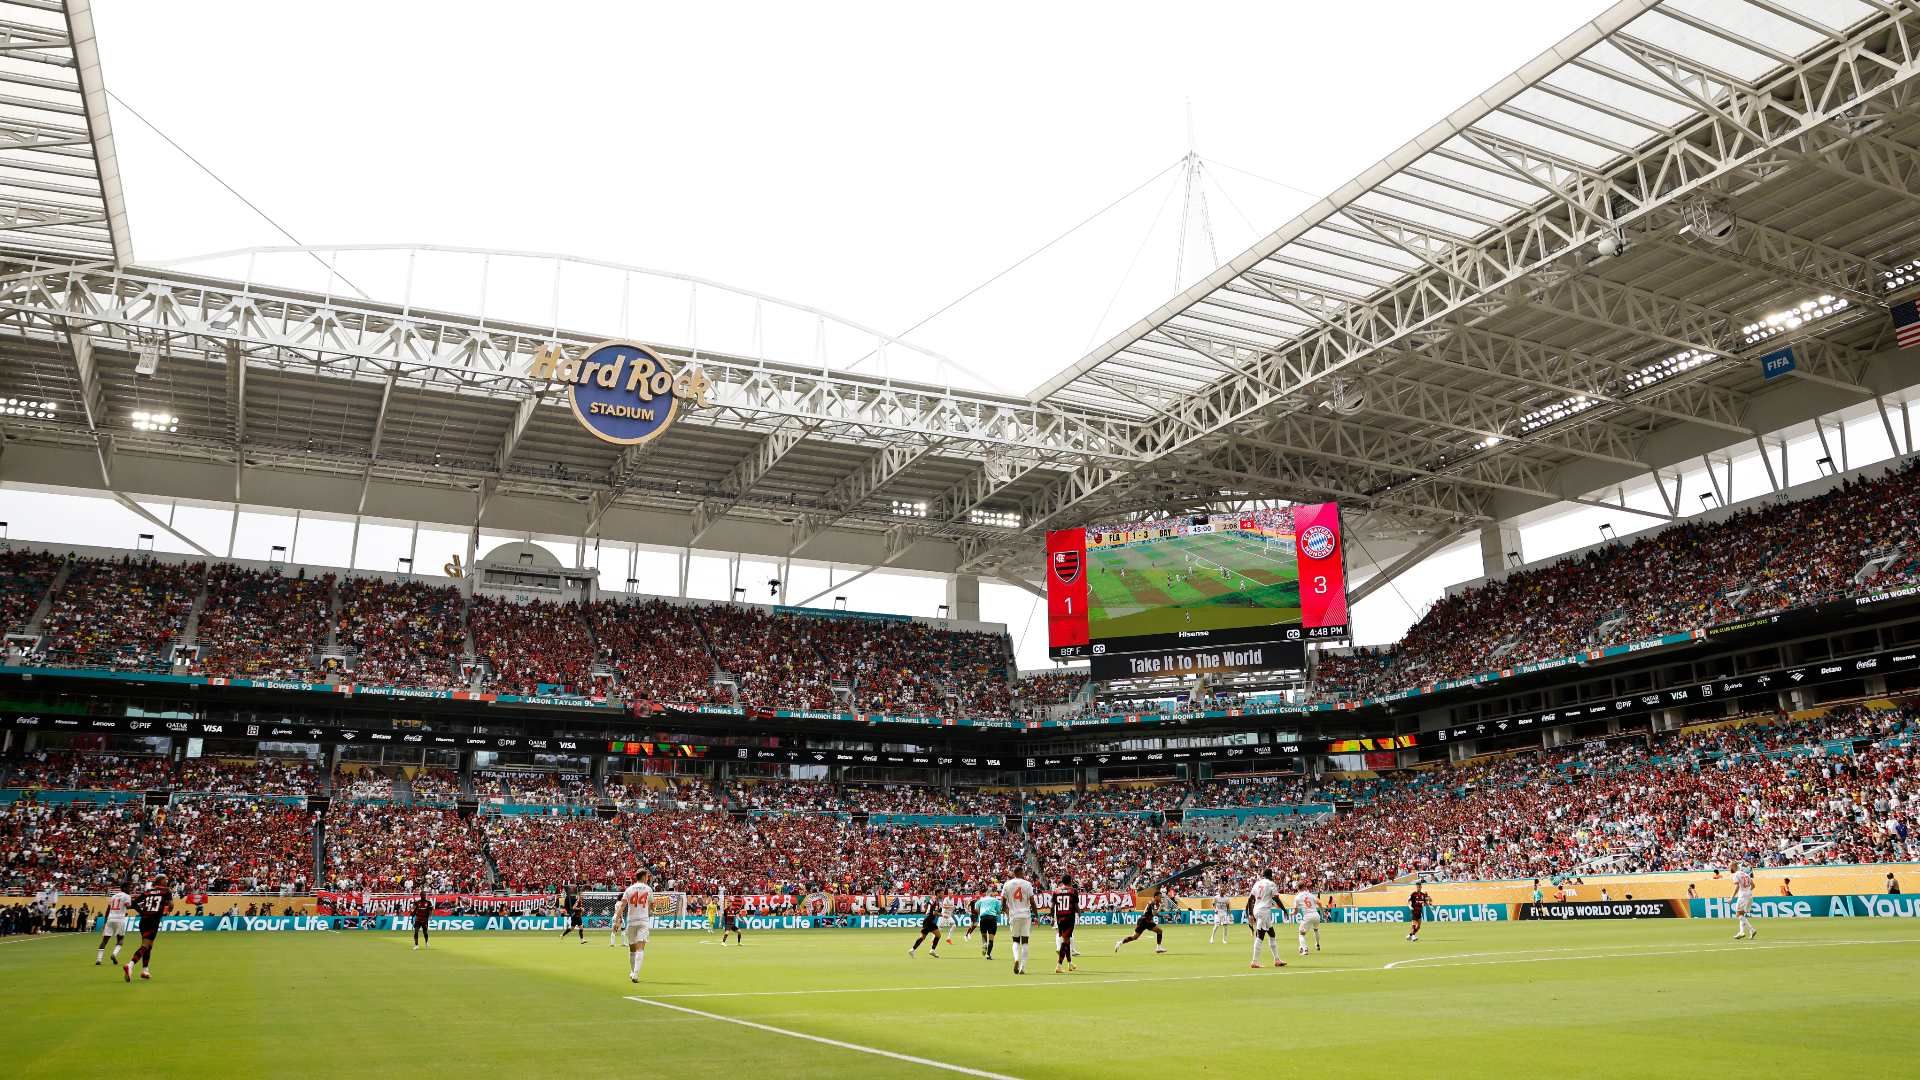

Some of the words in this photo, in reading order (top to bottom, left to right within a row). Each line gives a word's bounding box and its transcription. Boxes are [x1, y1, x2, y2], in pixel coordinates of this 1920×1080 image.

[1767, 356, 1790, 372] FIFA
[529, 343, 626, 389] Hard
[626, 357, 718, 409] Rock
[590, 402, 654, 421] STADIUM
[1109, 533, 1121, 543] FLA
[1159, 529, 1172, 537] BAY
[1314, 575, 1327, 594] 3
[1856, 596, 1871, 606] FIFA
[1872, 593, 1890, 602] CLUB
[1890, 588, 1916, 599] WORLD
[1064, 598, 1072, 614] 1
[1178, 630, 1209, 638] Hisense
[1309, 628, 1328, 636] 4:48
[1330, 626, 1343, 634] PM
[1093, 645, 1105, 653] CC
[1129, 658, 1161, 673] Take
[1163, 656, 1174, 671] It
[1177, 655, 1192, 669] To
[1196, 654, 1220, 667] The
[1222, 649, 1263, 667] World
[1821, 666, 1842, 675] Betano
[301, 683, 312, 691] 95
[435, 691, 447, 699] 75
[1670, 690, 1688, 700] VISA
[1621, 700, 1632, 709] PIF
[92, 720, 116, 728] Lenovo
[202, 725, 223, 733] VISA
[559, 742, 577, 750] VISA
[1281, 745, 1299, 753] VISA
[630, 891, 649, 908] 44
[1013, 886, 1023, 902] 4
[145, 896, 162, 912] 43
[1057, 895, 1070, 911] 50
[1829, 896, 1855, 917] AI
[1343, 907, 1404, 922] Hisense
[1432, 906, 1465, 921] Your
[1576, 905, 1611, 916] WORLD
[1613, 904, 1632, 915] CUP
[217, 916, 242, 931] AI
[243, 916, 291, 931] Your
[391, 915, 475, 931] Hiense
[485, 916, 504, 931] AI
[743, 916, 780, 929] Your
